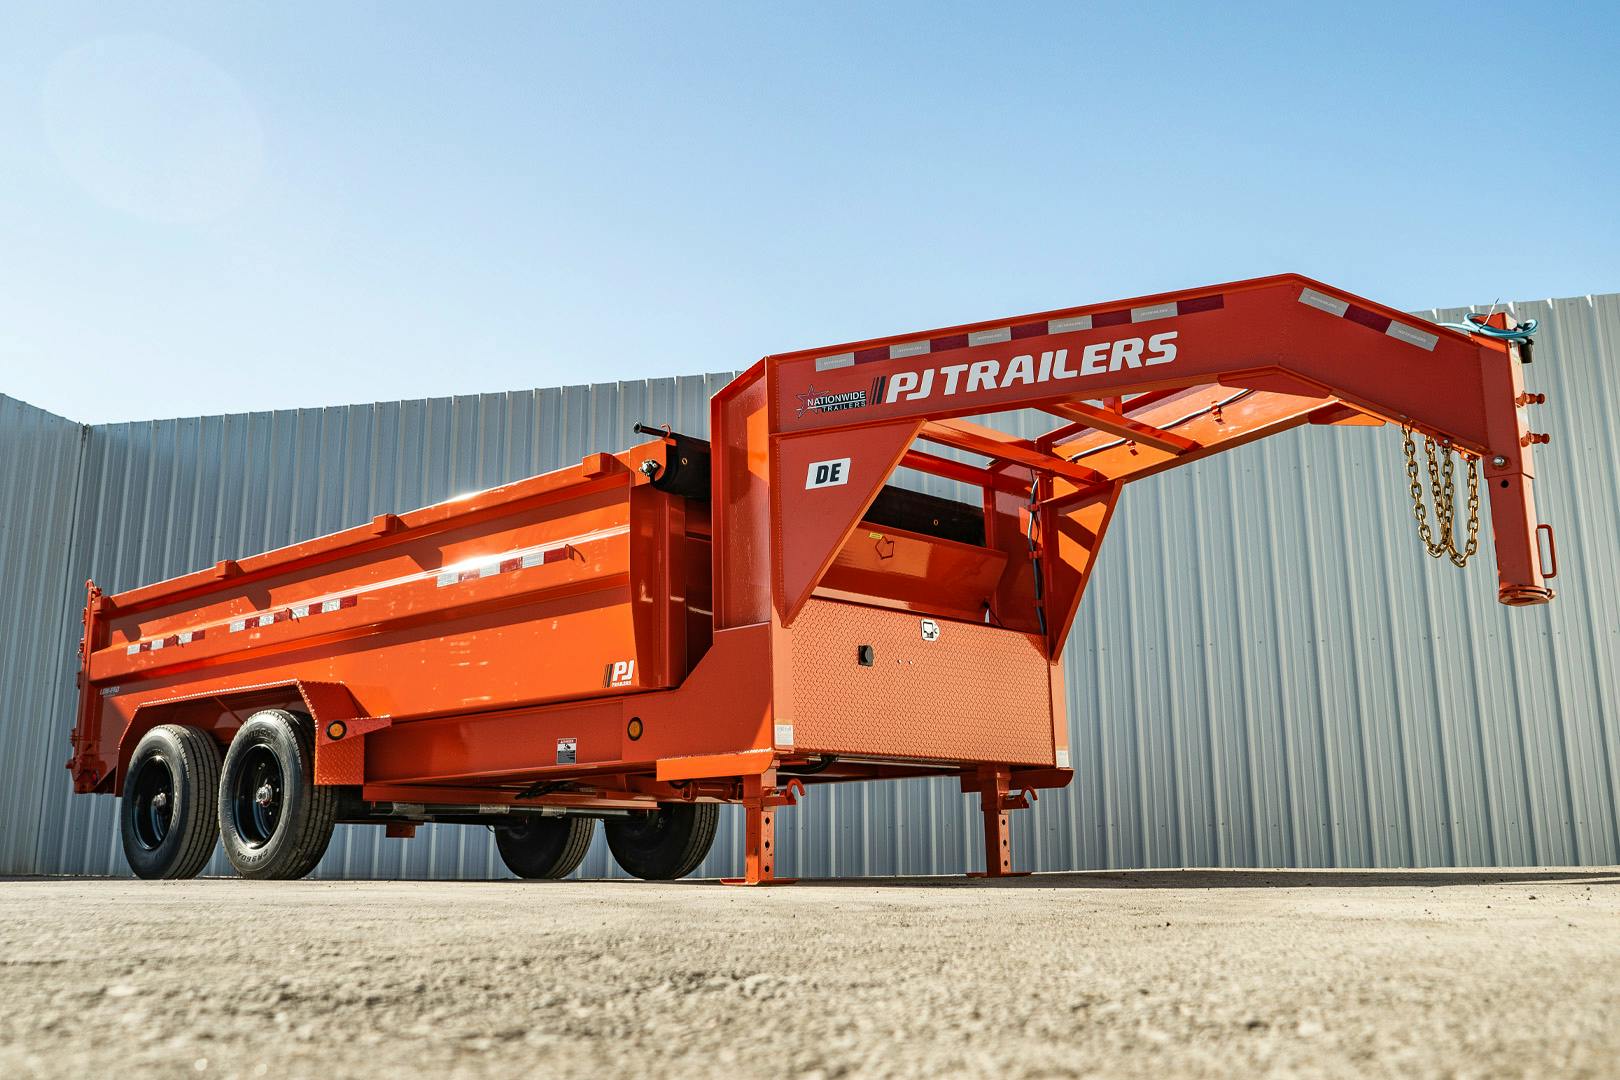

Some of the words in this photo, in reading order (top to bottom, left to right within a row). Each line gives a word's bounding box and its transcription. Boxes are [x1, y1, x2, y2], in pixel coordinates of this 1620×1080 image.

[886, 368, 935, 404] PJ
[940, 331, 1178, 396] TRAILERS
[807, 391, 866, 407] NATIONWIDE
[822, 401, 866, 412] TRAILERS
[815, 463, 842, 485] DE
[612, 660, 635, 681] PJ
